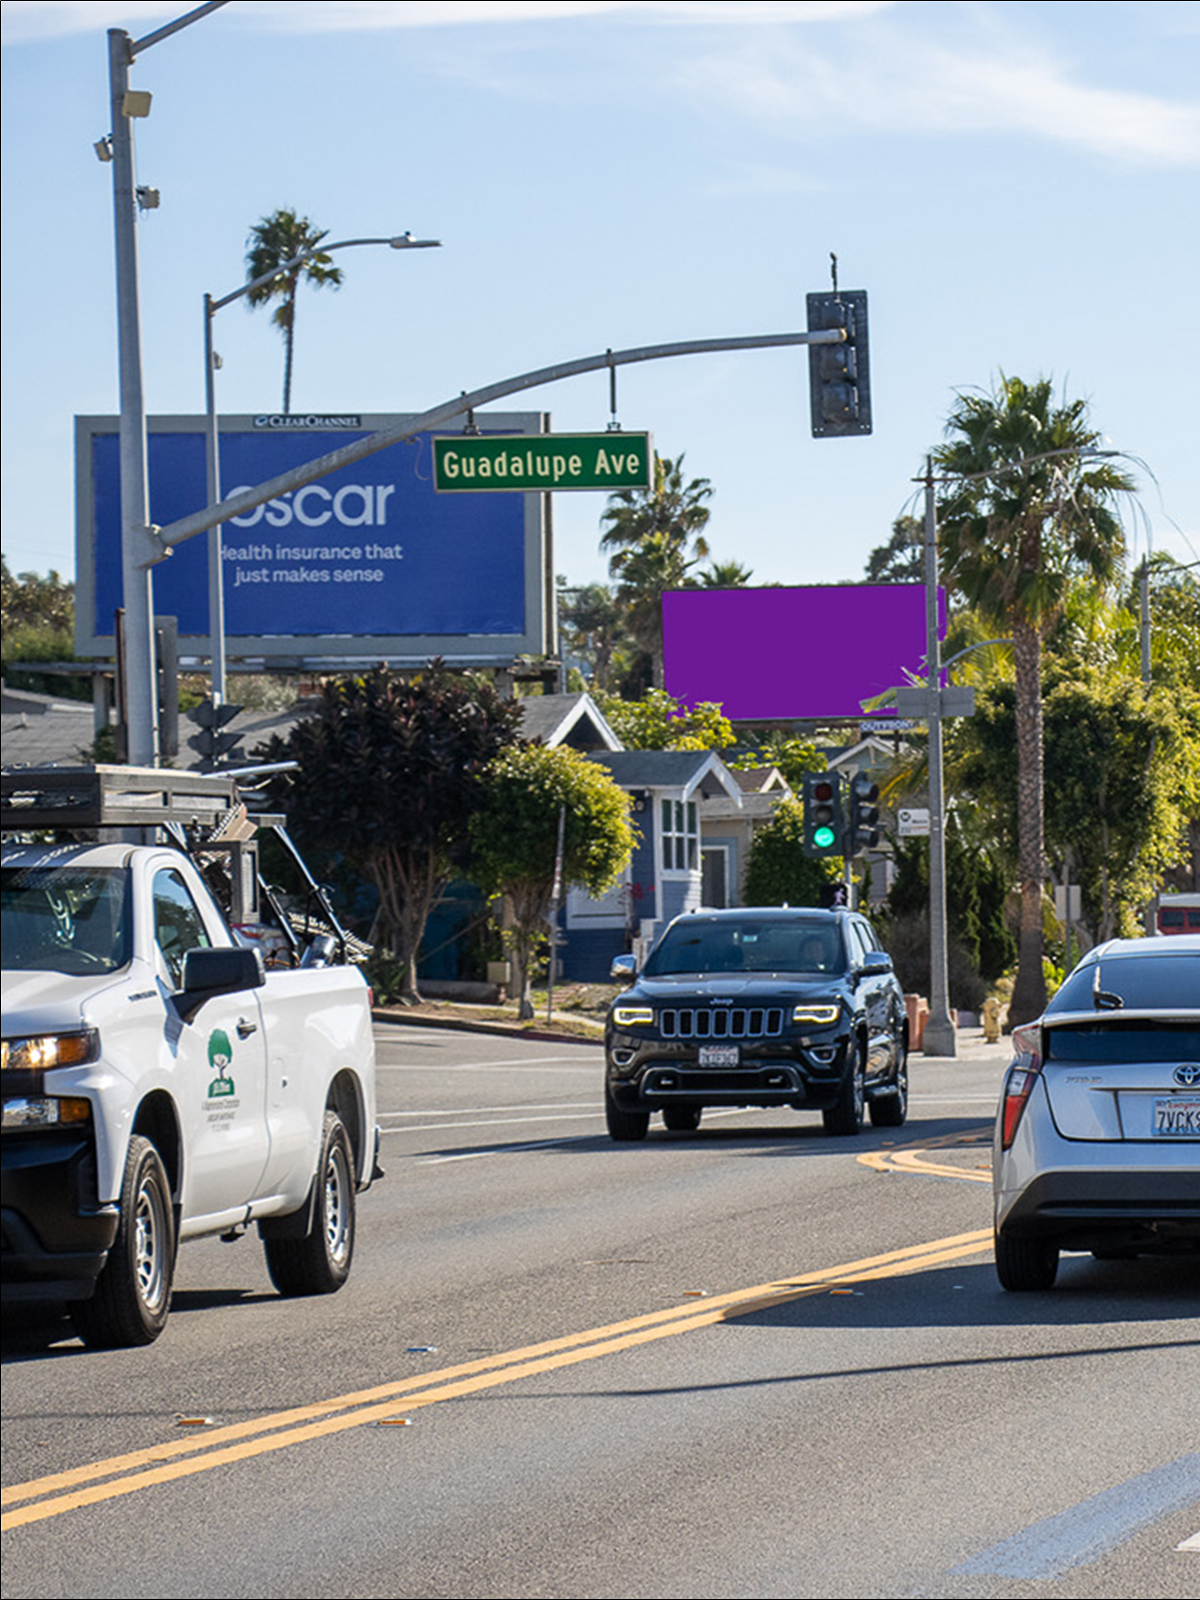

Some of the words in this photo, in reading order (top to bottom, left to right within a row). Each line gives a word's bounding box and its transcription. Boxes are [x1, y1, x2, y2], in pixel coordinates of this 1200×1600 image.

[443, 451, 583, 482] Guadalupe
[594, 449, 640, 475] Ave
[225, 484, 395, 527] oscar
[276, 544, 362, 560] insurance
[365, 544, 404, 560] that
[233, 566, 270, 587] just
[273, 567, 330, 582] makes
[333, 568, 384, 582] sense
